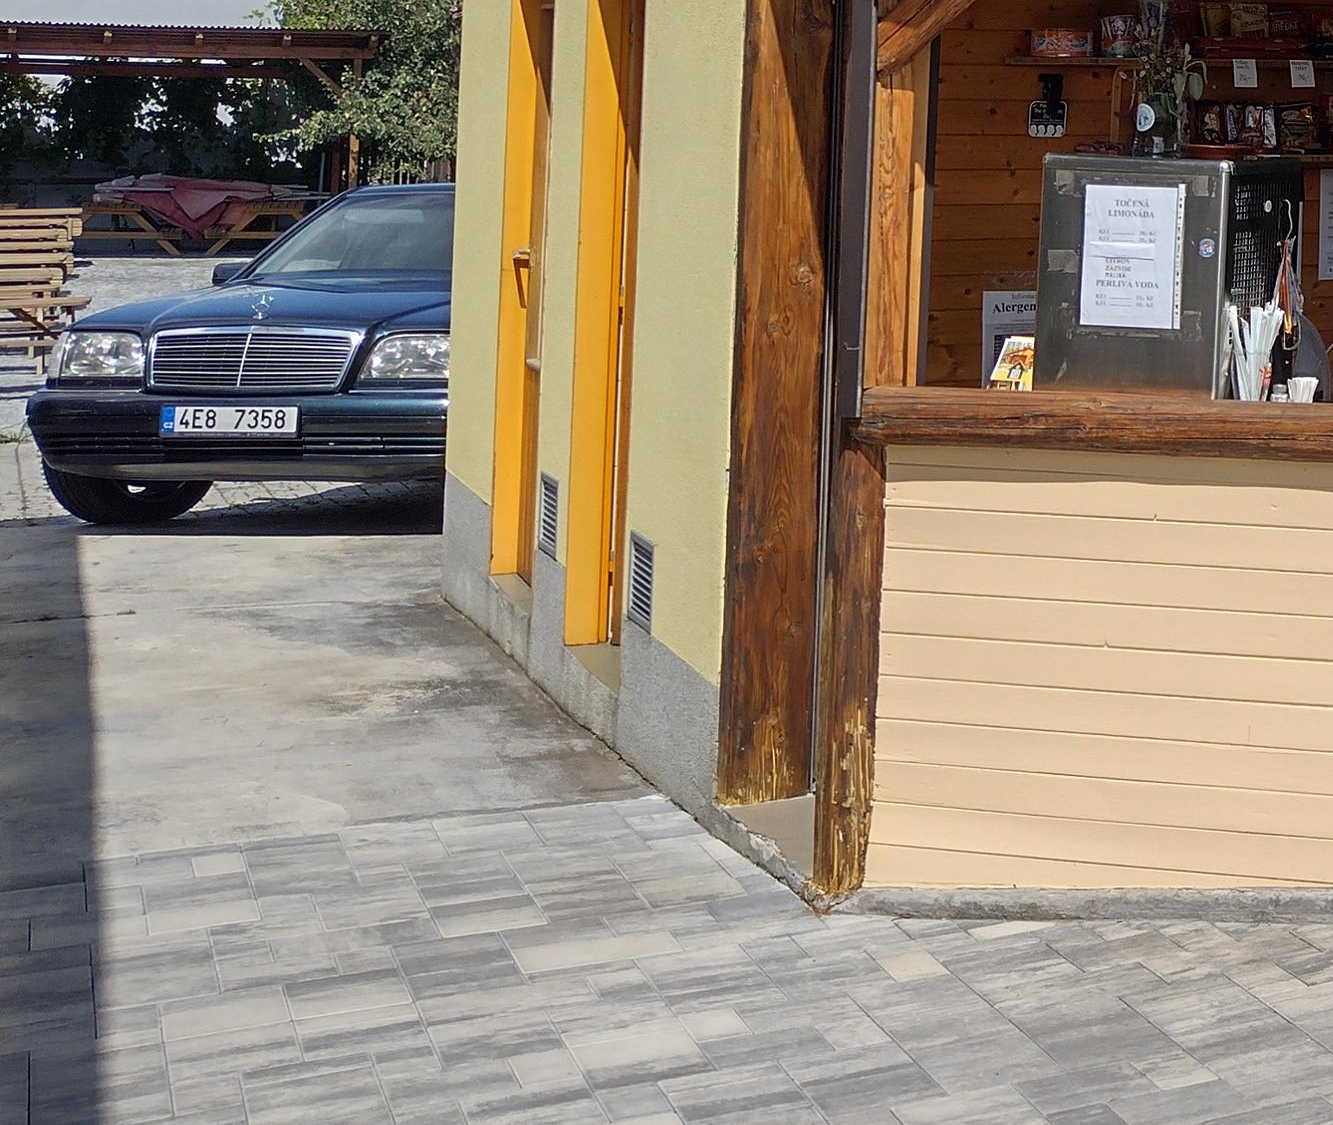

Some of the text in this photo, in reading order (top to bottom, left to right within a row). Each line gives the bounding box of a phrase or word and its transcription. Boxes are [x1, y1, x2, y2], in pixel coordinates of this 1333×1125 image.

[1114, 198, 1150, 208] TOČENÁ
[1108, 208, 1155, 219] LIMONÁDA
[1096, 279, 1159, 290] PERLIVÁ VODA
[179, 408, 286, 429] 4E8 7358
